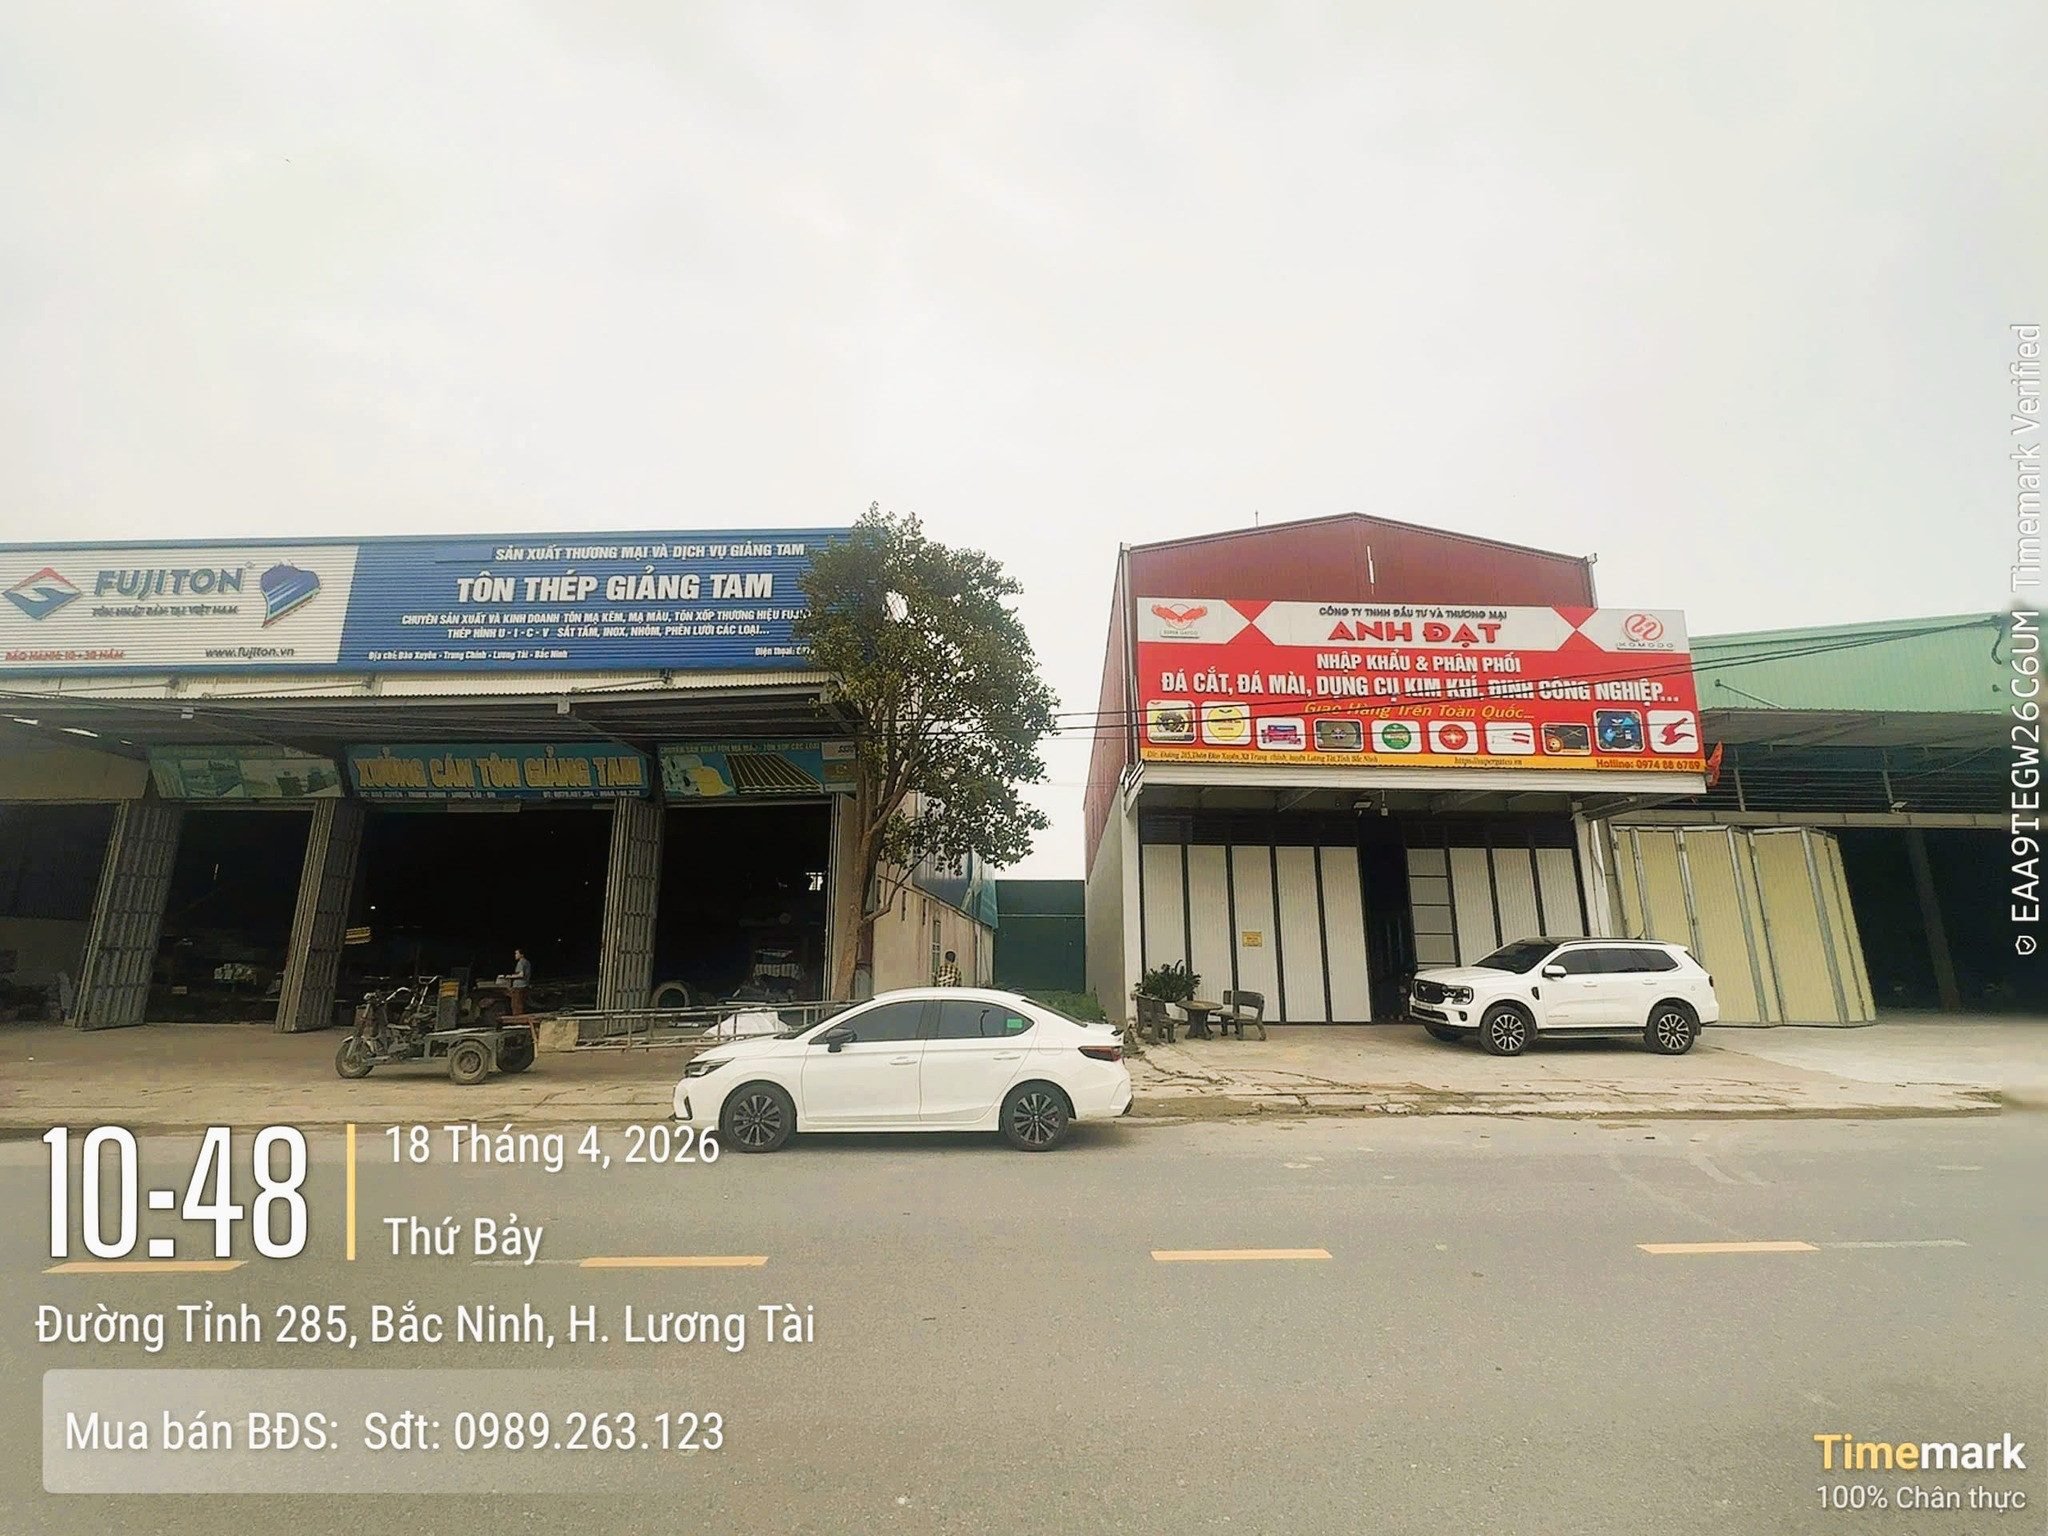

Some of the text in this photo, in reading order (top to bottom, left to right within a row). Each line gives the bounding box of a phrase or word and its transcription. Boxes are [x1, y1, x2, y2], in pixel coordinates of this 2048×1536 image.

[496, 540, 805, 562] SẢN XUẤT THƯƠNG MẠI VÀ DỊCH VỤ GIẢNG TAM
[93, 567, 245, 601] FUJITON
[456, 565, 773, 603] TÔN THÉP GIẢNG TAM
[489, 611, 501, 625] VÀ
[503, 612, 527, 625] KINH
[527, 612, 560, 625] DOANH
[1319, 605, 1508, 621] CÔNG TY TNHH ĐẦU TƯ VÀ THƯƠNG MẠI
[1328, 620, 1502, 648] ANH ĐẠT
[204, 646, 295, 659] www.fujiton.vn
[1316, 649, 1521, 673] NHẬP KHẨU & PHÂN PHỐI
[1161, 667, 1188, 692] ĐÁ
[1193, 666, 1234, 696] CẮT,
[1237, 670, 1266, 694] ĐÁ
[1269, 670, 1313, 697] MÀI,
[1316, 676, 1369, 699] DỤNG
[1373, 676, 1399, 702] CỤ
[1404, 678, 1440, 698] KIM
[1488, 679, 1534, 700] ĐINH
[1539, 675, 1591, 700] CÔNG
[1595, 678, 1680, 706] NGHIỆP...
[1304, 701, 1536, 720] Giao Hàng Trên Toàn Quốc...
[353, 745, 642, 788] XƯỞNG CÁN TÔN GIẢNG TAM
[1595, 758, 1634, 768] Hotline:
[1636, 759, 1660, 769] 0974
